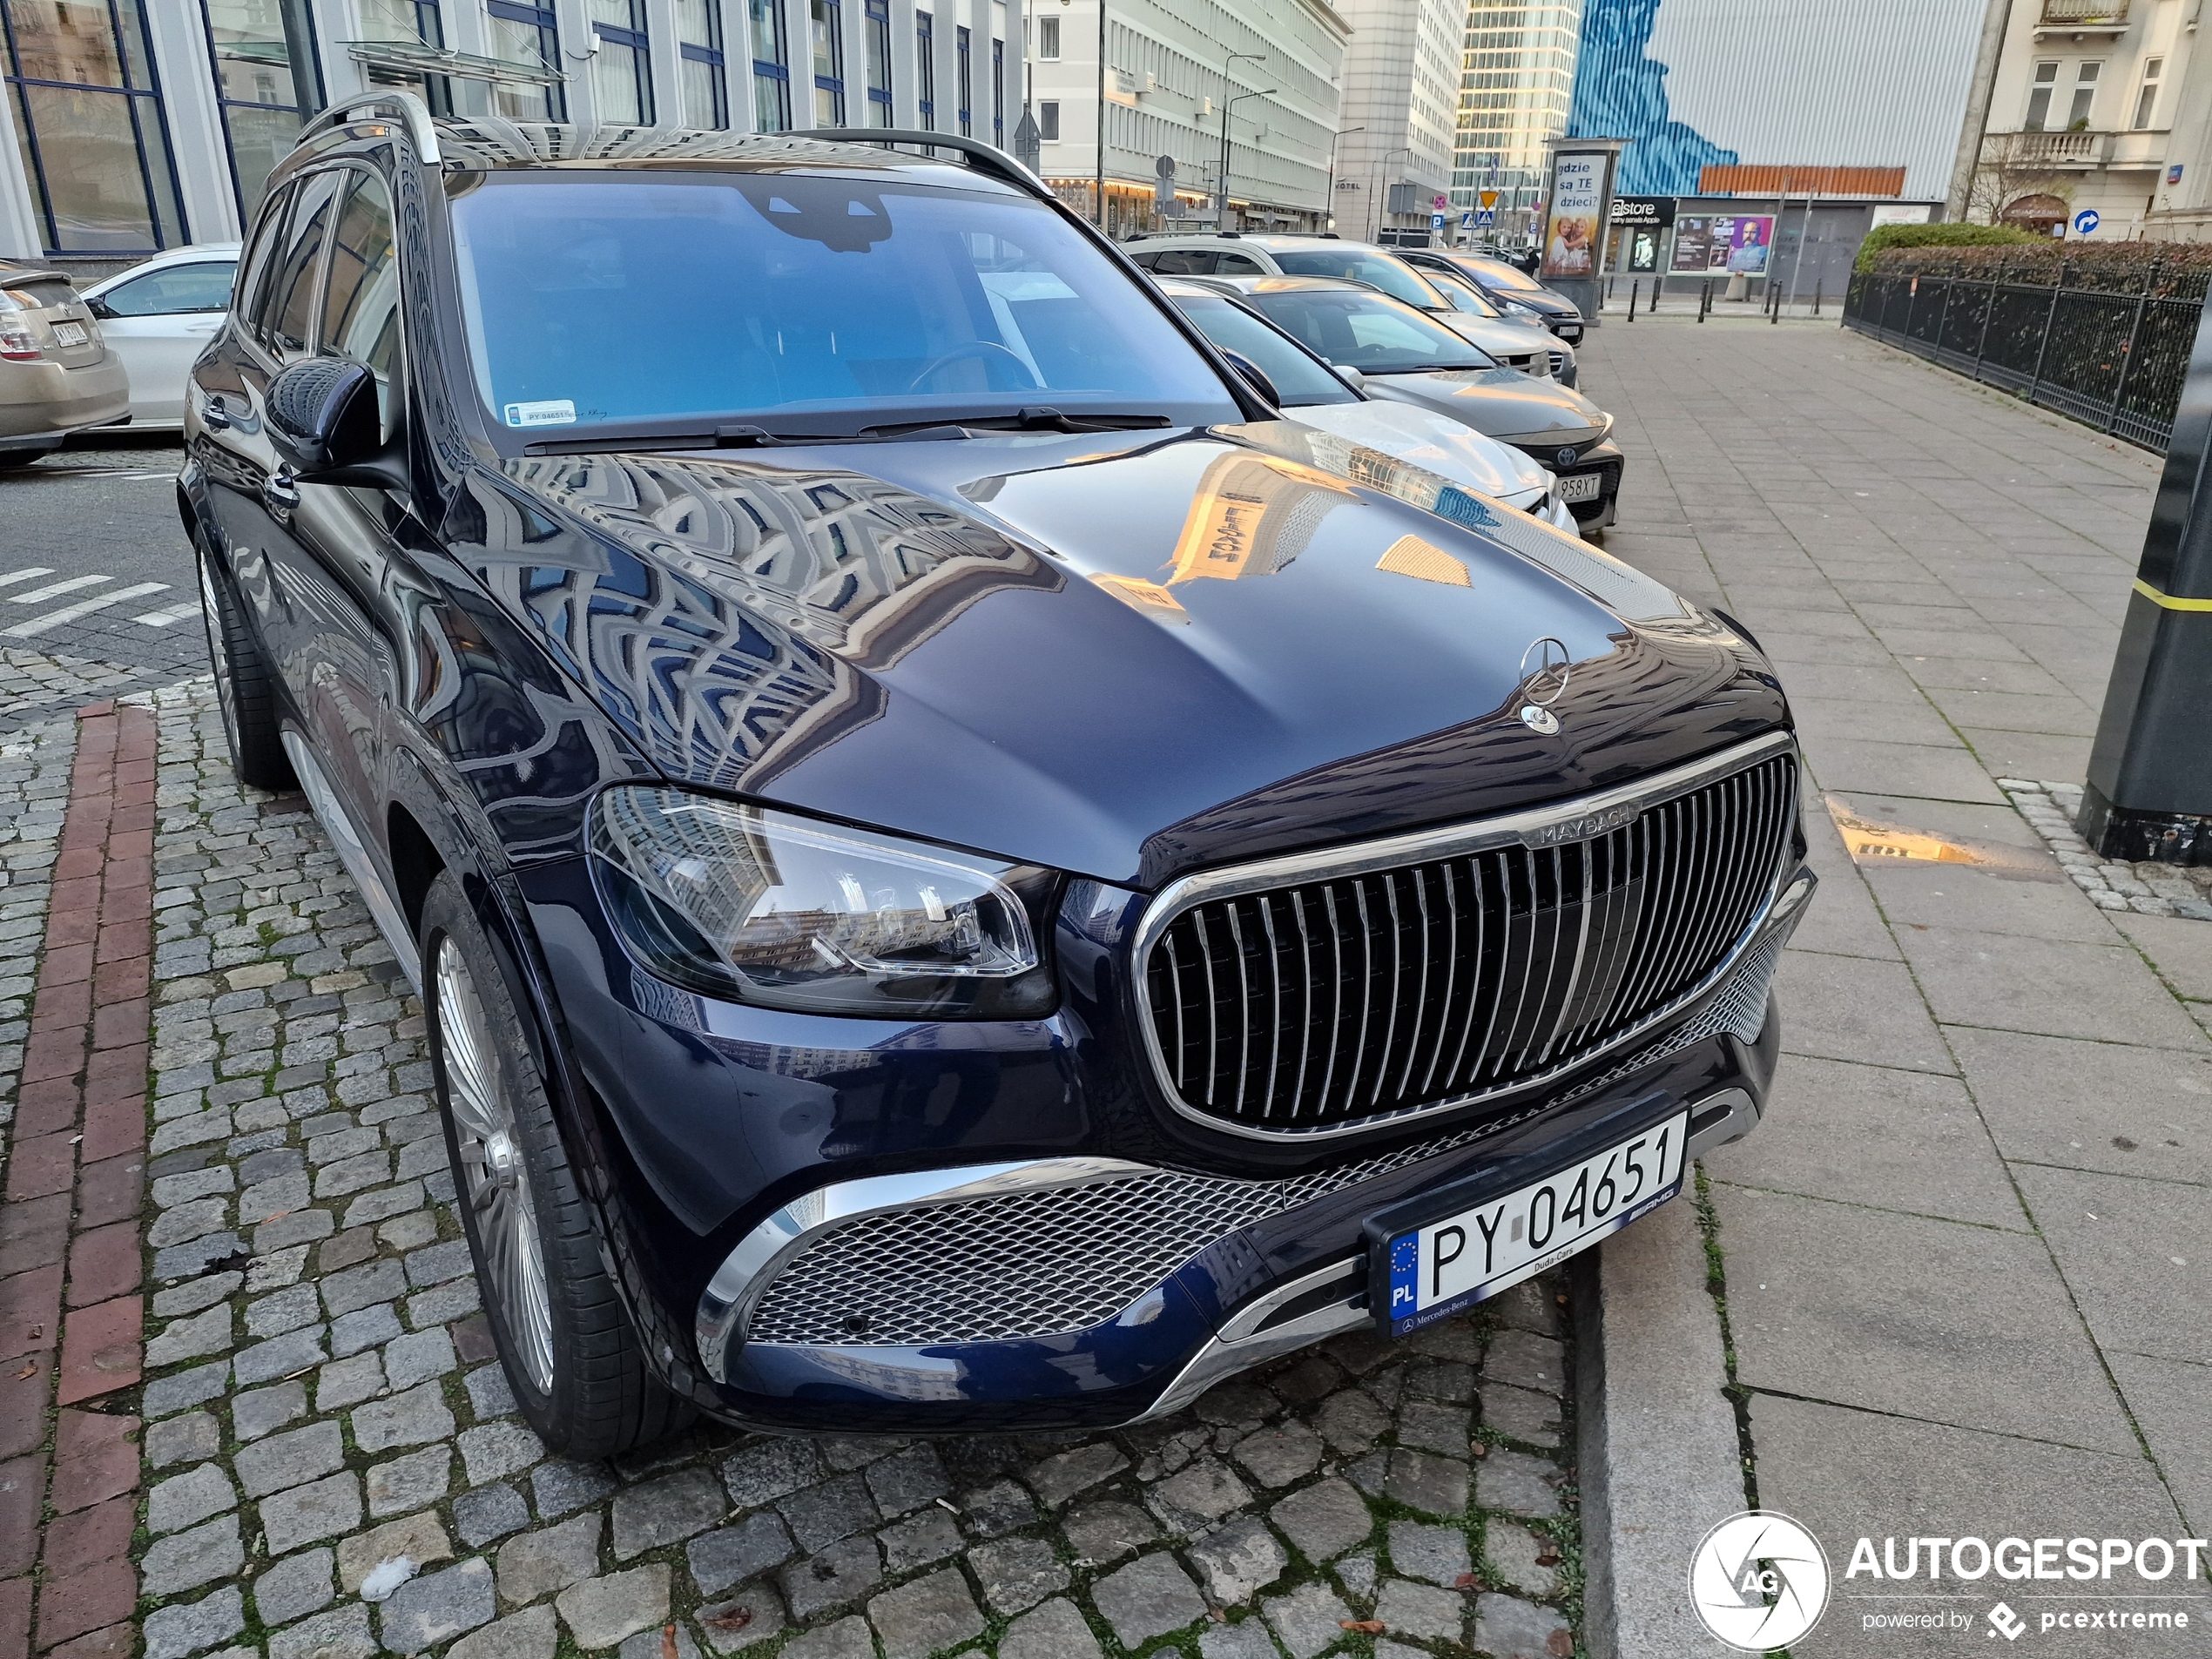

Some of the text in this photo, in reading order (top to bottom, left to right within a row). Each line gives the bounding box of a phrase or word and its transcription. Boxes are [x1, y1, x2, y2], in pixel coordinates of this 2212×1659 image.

[1558, 162, 1590, 176] gdzie
[1559, 178, 1593, 192] są TE
[1560, 196, 1598, 207] dzieci?
[1643, 216, 1661, 225] Apple
[1561, 476, 1598, 498] 958XT
[1539, 805, 1631, 844] MAYBACH
[1432, 1126, 1670, 1298] PY 04651
[1534, 1246, 1574, 1273] Duda-Cars
[1393, 1286, 1414, 1307] PL
[1416, 1298, 1469, 1326] Mercedes-Benz
